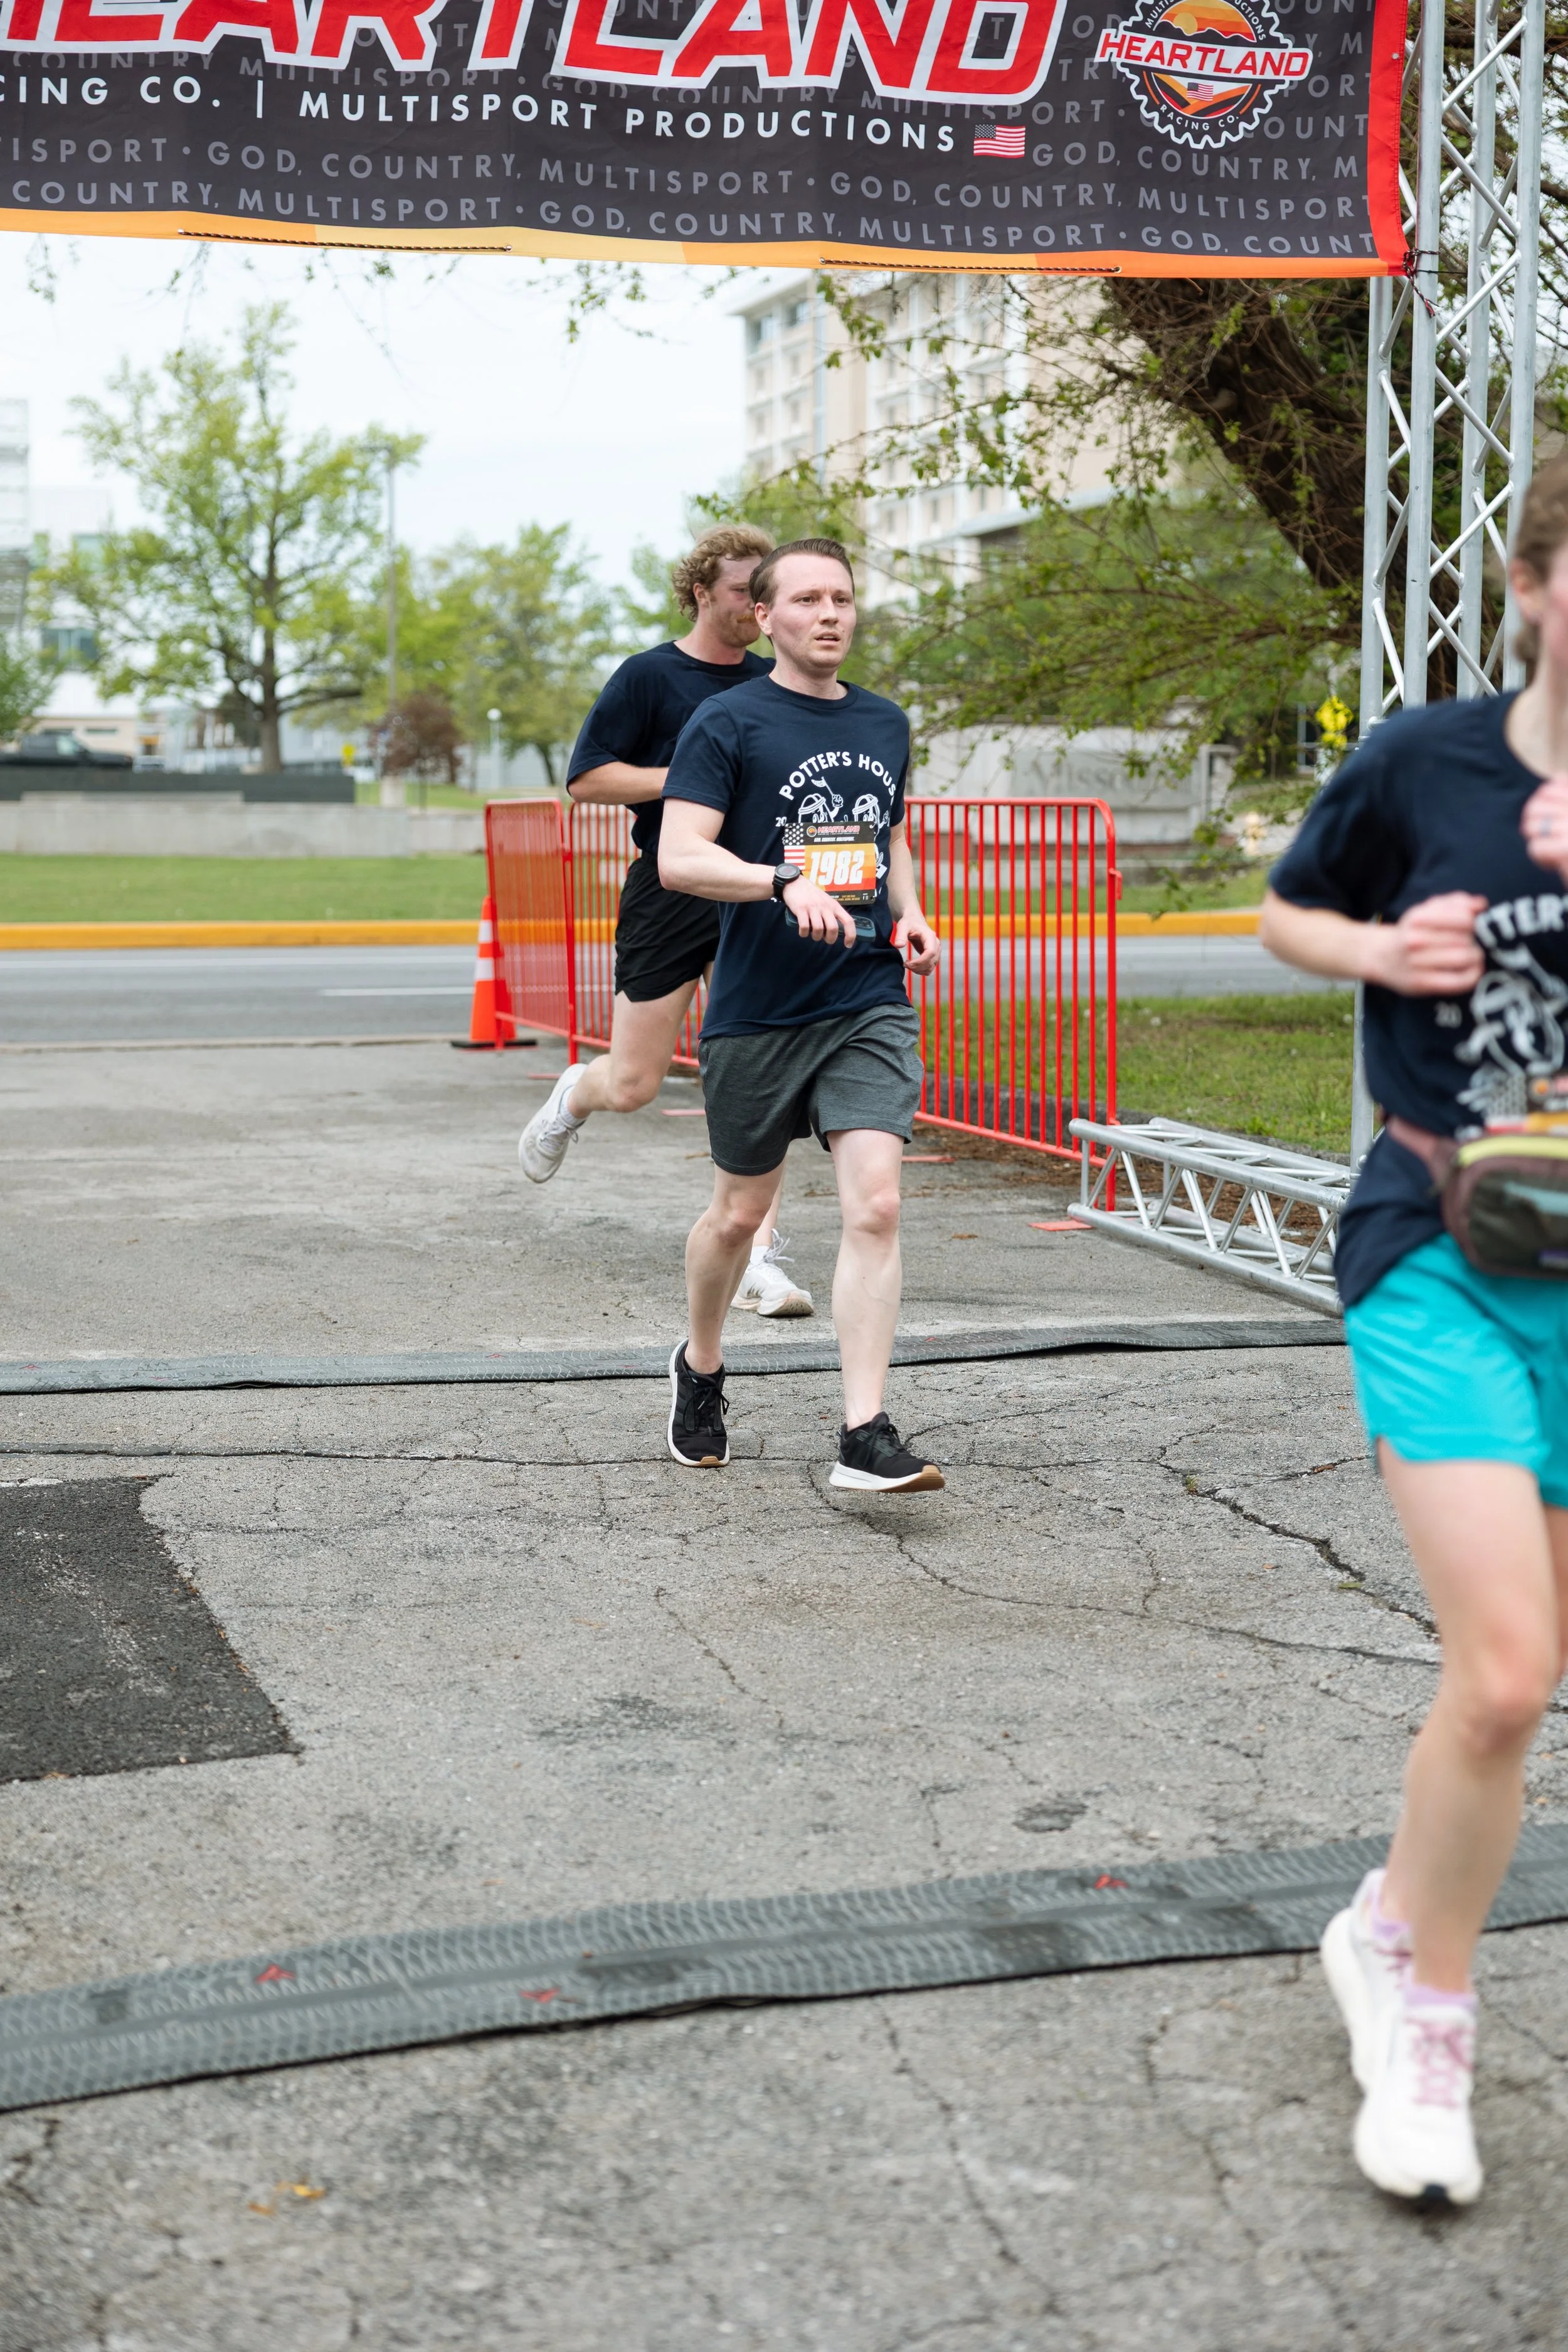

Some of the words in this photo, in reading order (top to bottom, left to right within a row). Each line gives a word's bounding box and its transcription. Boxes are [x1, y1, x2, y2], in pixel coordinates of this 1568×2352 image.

[1145, 0, 1174, 28] MULTI
[1099, 32, 1310, 77] HEARTLAND
[140, 76, 220, 107] CO.
[299, 90, 597, 129] MULTISPORT
[626, 108, 954, 152] PRODUCTIONS
[1160, 103, 1210, 130] RACING
[1218, 115, 1239, 128] CO.
[208, 142, 302, 176] GOD,
[322, 154, 521, 180] COUNTRY,
[540, 159, 793, 195] MULTISPORT
[830, 172, 916, 206] GOD,
[935, 183, 1122, 208] COUNTRY,
[1032, 141, 1121, 167] GOD,
[1138, 146, 1316, 181] COUNTRY,
[13, 180, 219, 208] COUNTRY,
[238, 188, 501, 221] MULTISPORT
[539, 201, 631, 233] GOD,
[649, 212, 842, 237] COUNTRY,
[860, 217, 1104, 248] MULTISPORT
[779, 751, 852, 801] POTTER'S
[809, 850, 865, 886] 1982
